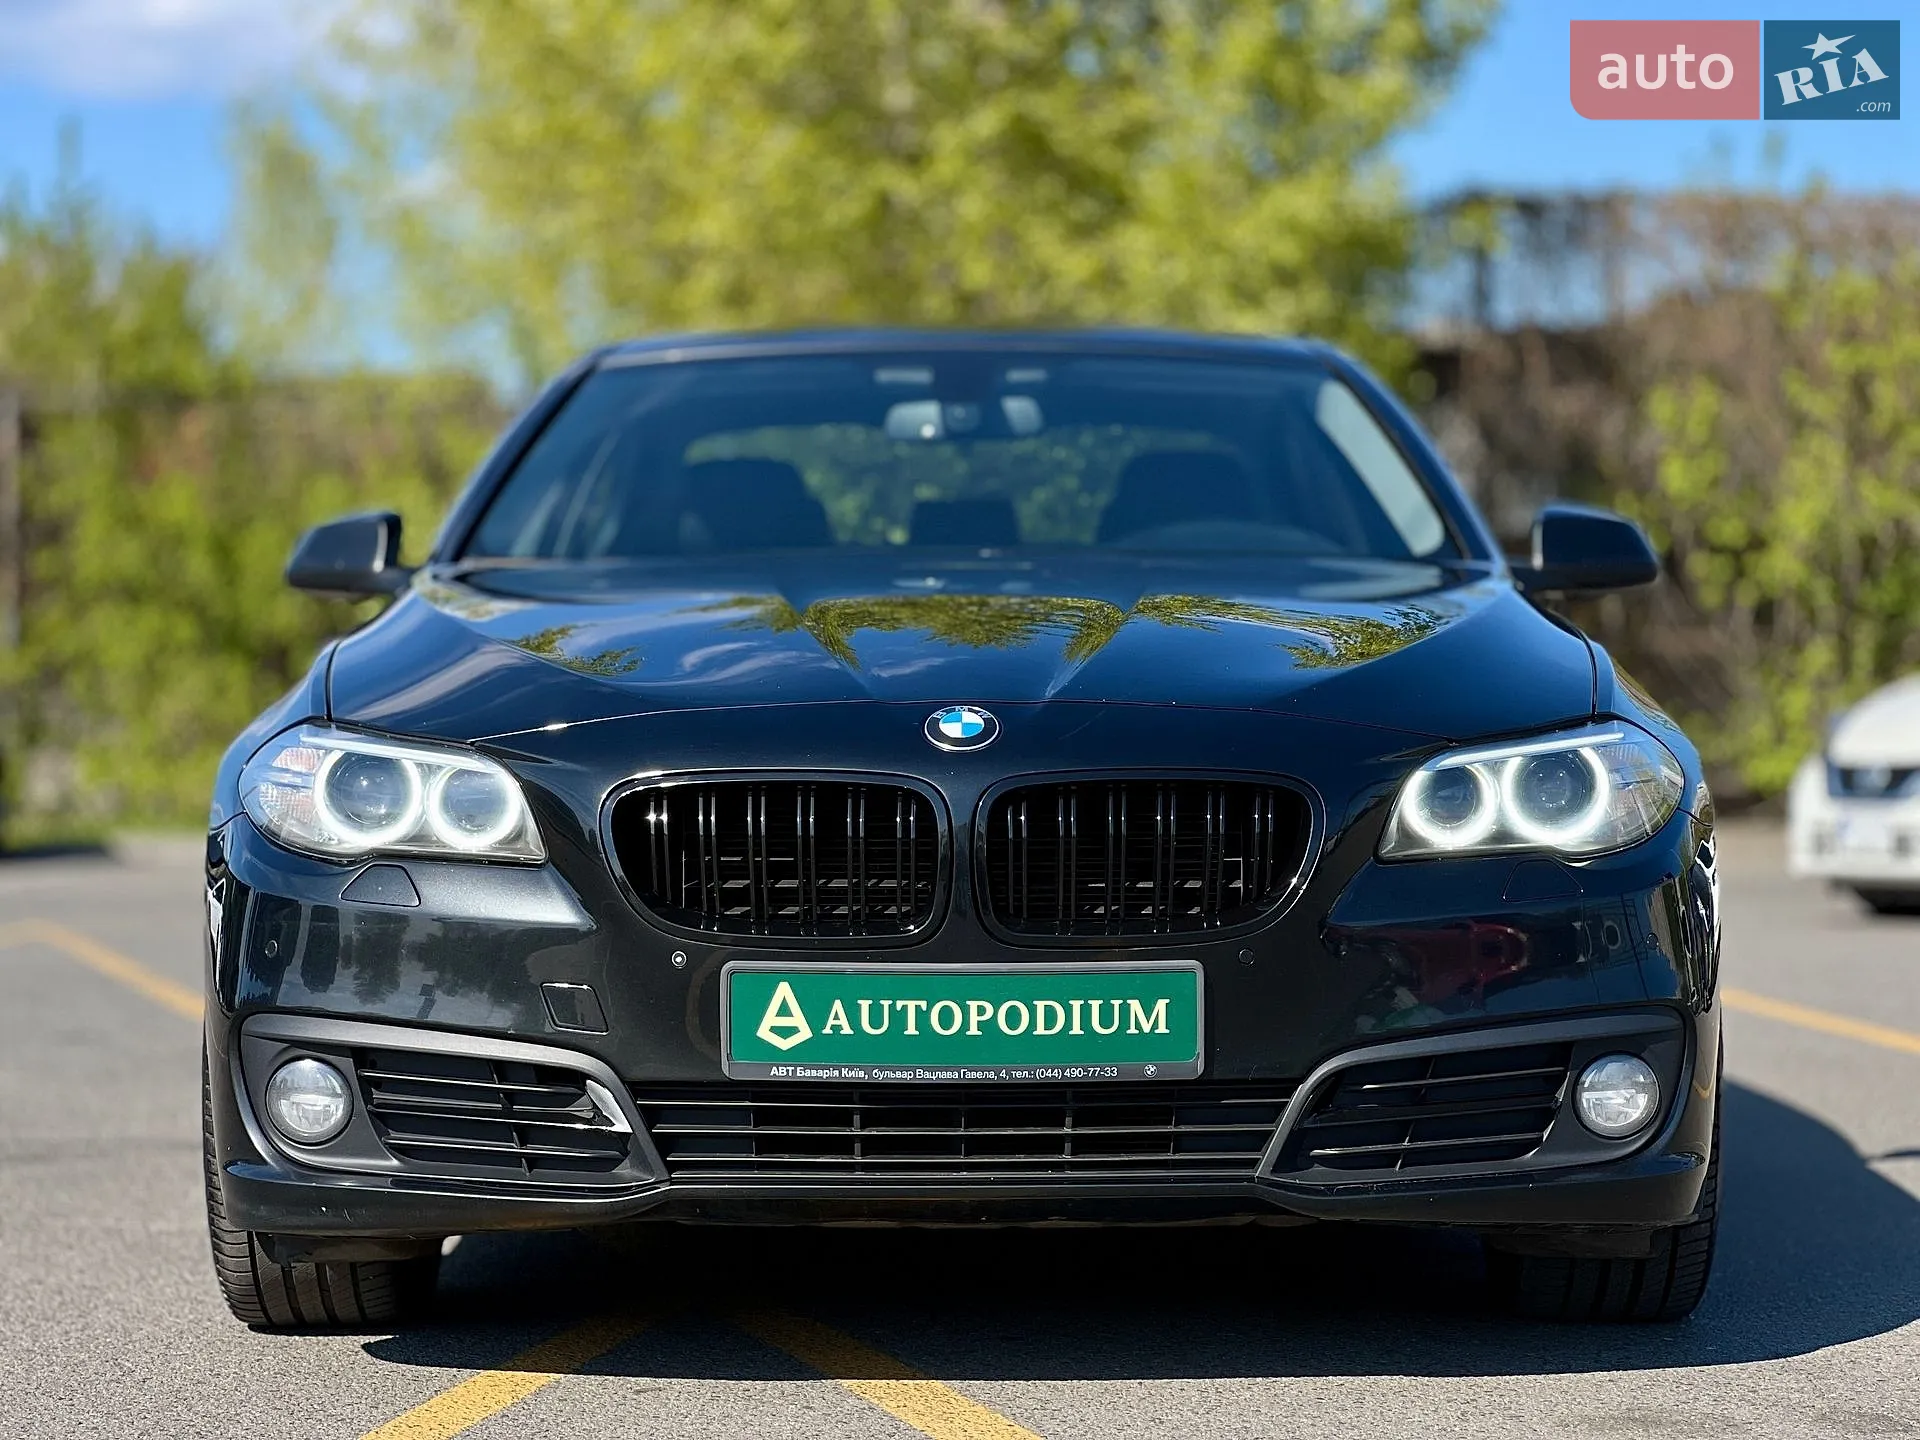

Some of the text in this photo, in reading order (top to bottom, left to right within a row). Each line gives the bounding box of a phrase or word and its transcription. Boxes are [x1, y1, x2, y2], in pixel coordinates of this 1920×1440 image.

[821, 998, 1171, 1036] AUTOPODIUM
[796, 1067, 840, 1080] Баварія
[841, 1066, 869, 1080] Київ,
[872, 1068, 914, 1081] бульвар
[916, 1069, 959, 1081] Вацлава
[960, 1069, 998, 1081] Гавела,
[1035, 1068, 1062, 1080] (044)
[1063, 1067, 1118, 1078] 490-77-33
